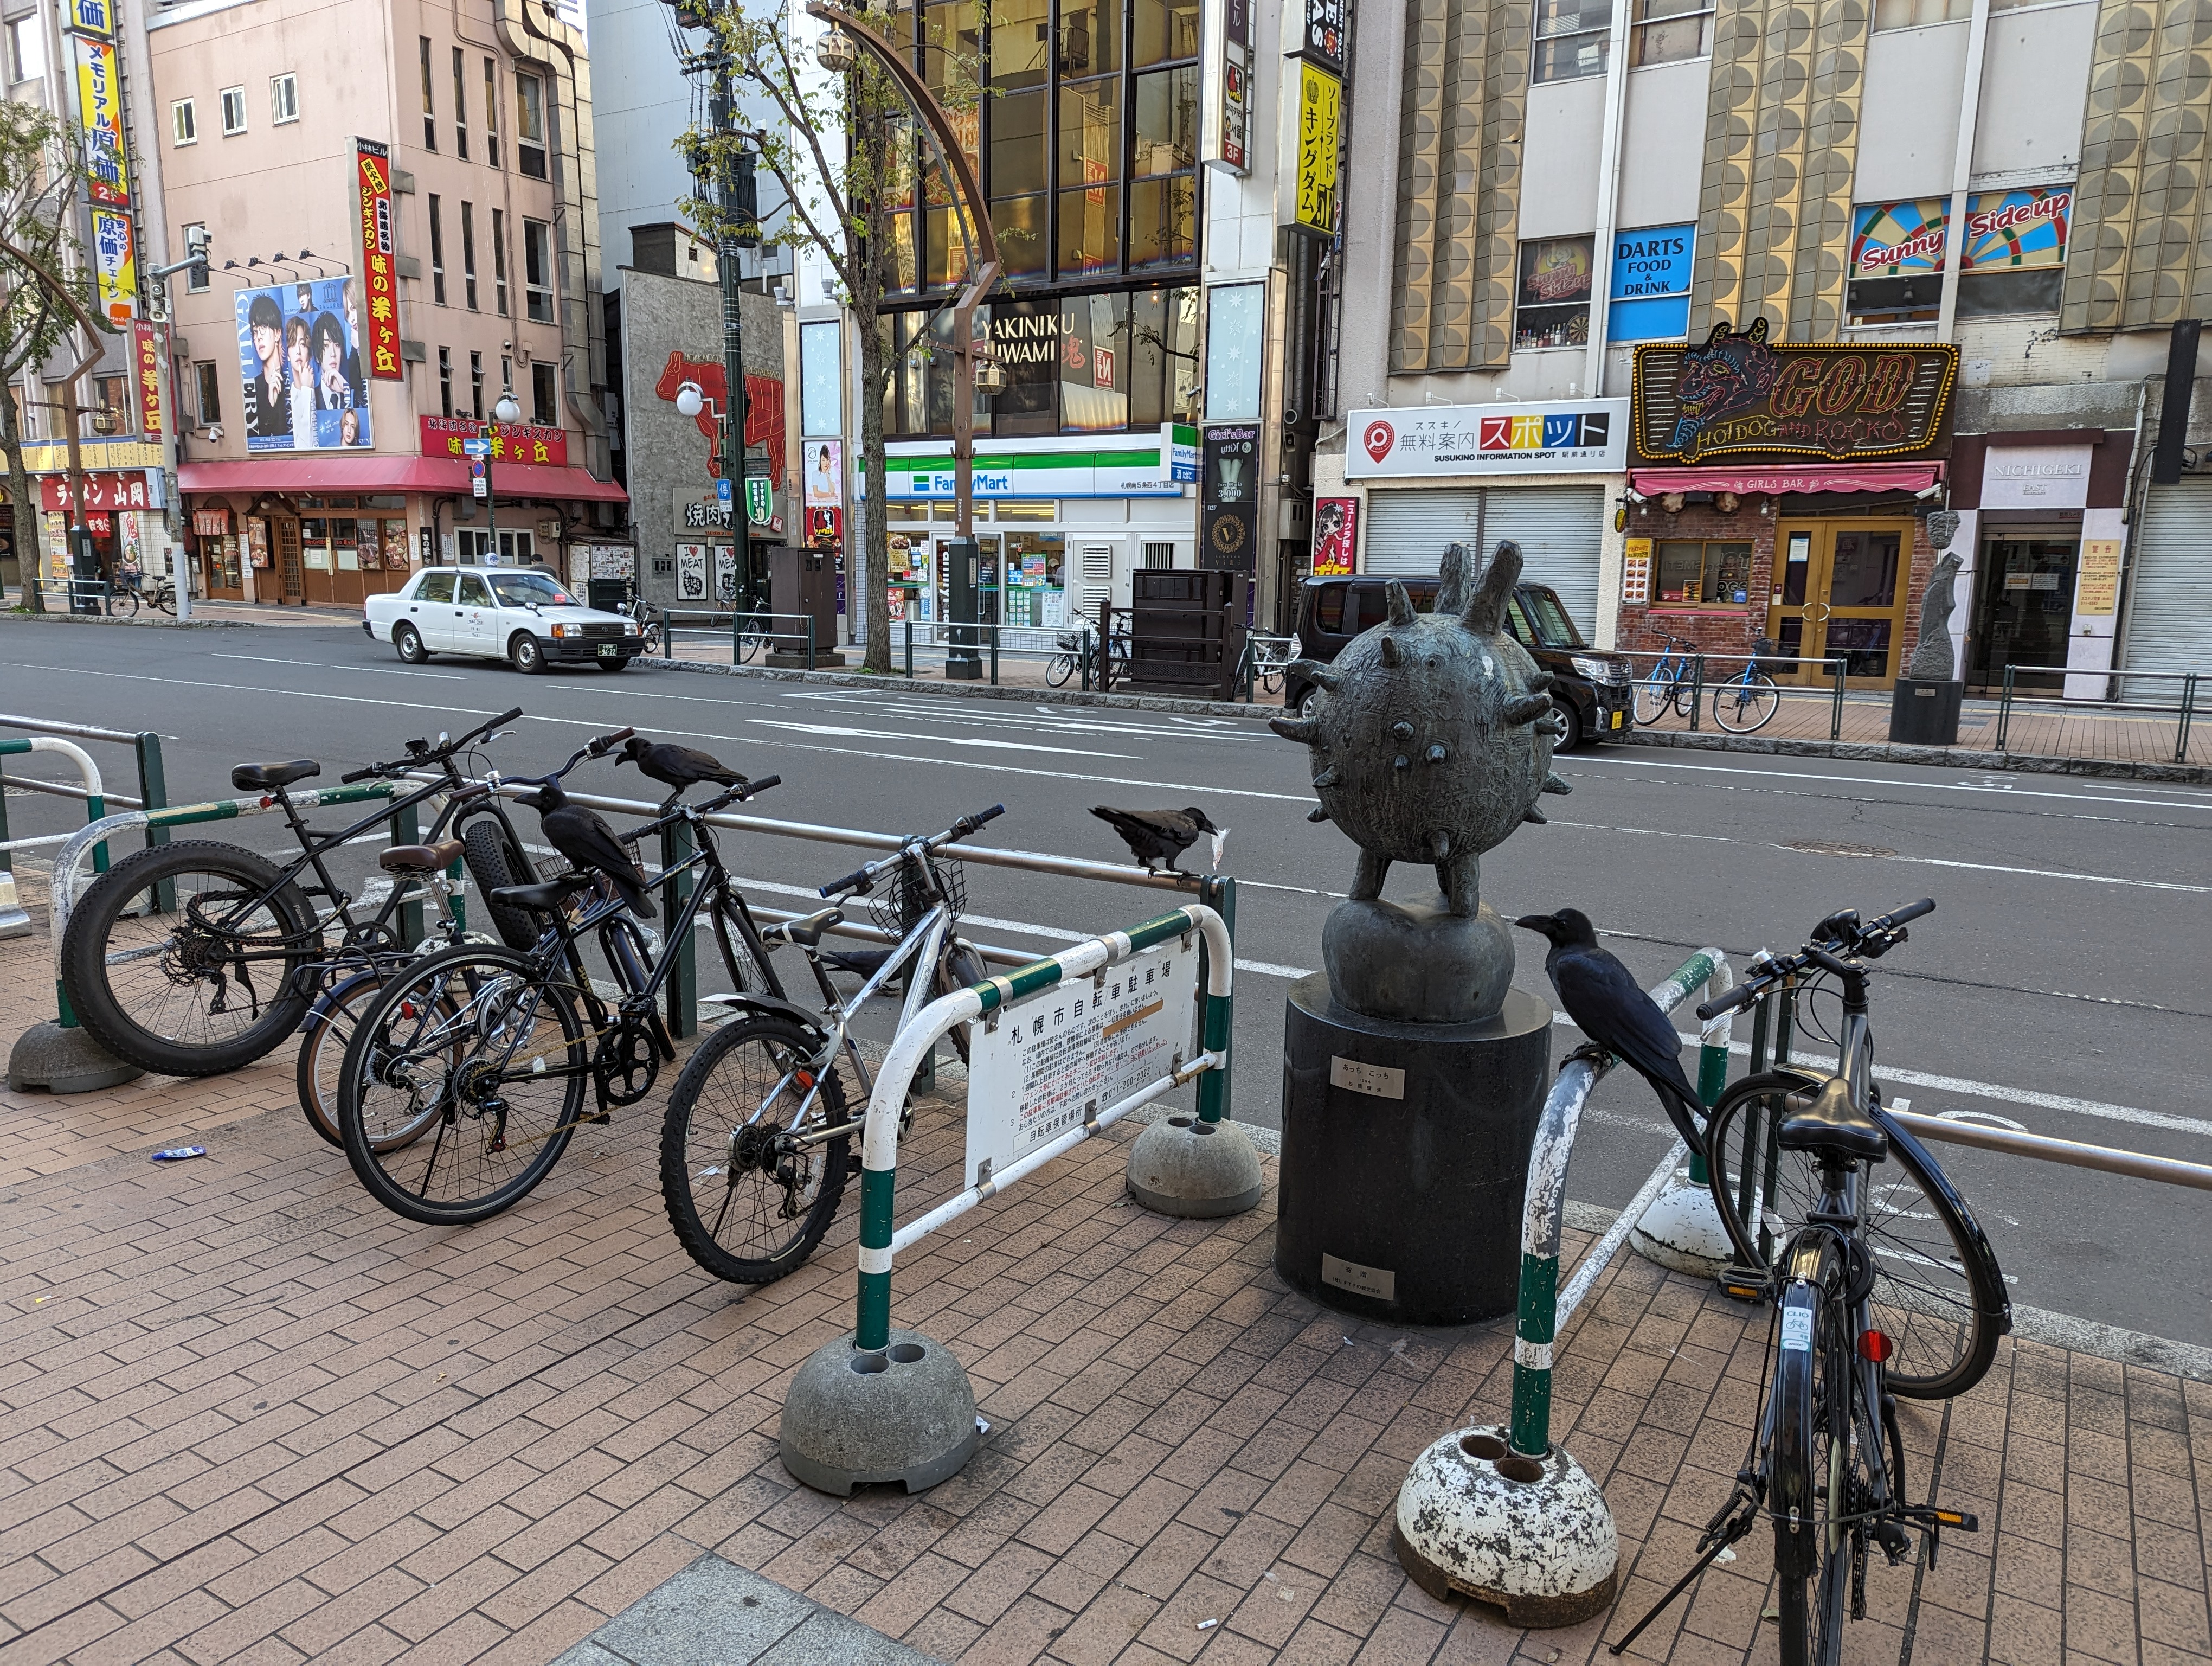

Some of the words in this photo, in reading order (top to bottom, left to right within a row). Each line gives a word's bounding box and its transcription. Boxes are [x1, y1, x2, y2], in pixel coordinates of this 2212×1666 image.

[1325, 85, 1336, 179] ソープランド
[357, 141, 387, 156] 小林ビル
[1227, 144, 1238, 161] 3F
[1301, 107, 1319, 213] キングダム
[364, 160, 385, 191] 炭火焼
[1316, 183, 1334, 229] 5F
[362, 186, 376, 249] ジンギスカン
[378, 200, 390, 251] 北海道名物
[115, 220, 127, 251] 安心の
[98, 215, 120, 298] 原価チェーン
[1618, 237, 1684, 260] DARTS
[1861, 230, 1945, 271] Sunny
[1627, 259, 1671, 274] FOOD
[1644, 273, 1652, 281] &
[1624, 280, 1670, 295] DRINK
[982, 312, 1075, 340] YAKINIKU
[684, 353, 719, 362] HOKKAIDO
[983, 339, 1054, 364] IWAMI
[236, 293, 260, 436] GALLERY
[1769, 354, 1917, 418] GOD
[282, 366, 294, 433] TSUKASA
[428, 418, 477, 433] 北海道名物
[500, 425, 563, 441] ジンギスカン
[1415, 421, 1462, 430] ススキノ
[1481, 414, 1606, 448] スポット
[1780, 421, 1811, 438] AND
[447, 436, 550, 463] 味羊ヶ丘
[1399, 432, 1475, 452] 無料案内
[1172, 448, 1197, 460] FamilyMart
[1476, 452, 1533, 461] INFORMATION
[1534, 451, 1557, 459] SPOT
[1561, 450, 1606, 459] 駅前通り店
[1176, 469, 1182, 480] 酒
[1182, 470, 1192, 480] たばこ
[1992, 464, 2082, 477] NICHIGEKI
[720, 483, 729, 497] 停
[935, 475, 1008, 492] FamyMart
[1120, 481, 1174, 489] 札幌南5条西4丁目店
[1747, 479, 1778, 489] GIRLS
[1783, 478, 1805, 488] BAR
[1218, 489, 1242, 498] 3,000
[1341, 500, 1355, 560] ニュークラ探しは
[684, 546, 690, 556] I
[722, 548, 728, 558] I
[680, 558, 703, 569] MEAT
[718, 558, 735, 569] MEA
[293, 904, 308, 930] Panarac
[1011, 960, 1171, 1047] 札幌市自転車駐車場
[1343, 1063, 1361, 1074] あっち
[1369, 1069, 1389, 1079] こっち
[1030, 1106, 1083, 1143] 自転車保管場所
